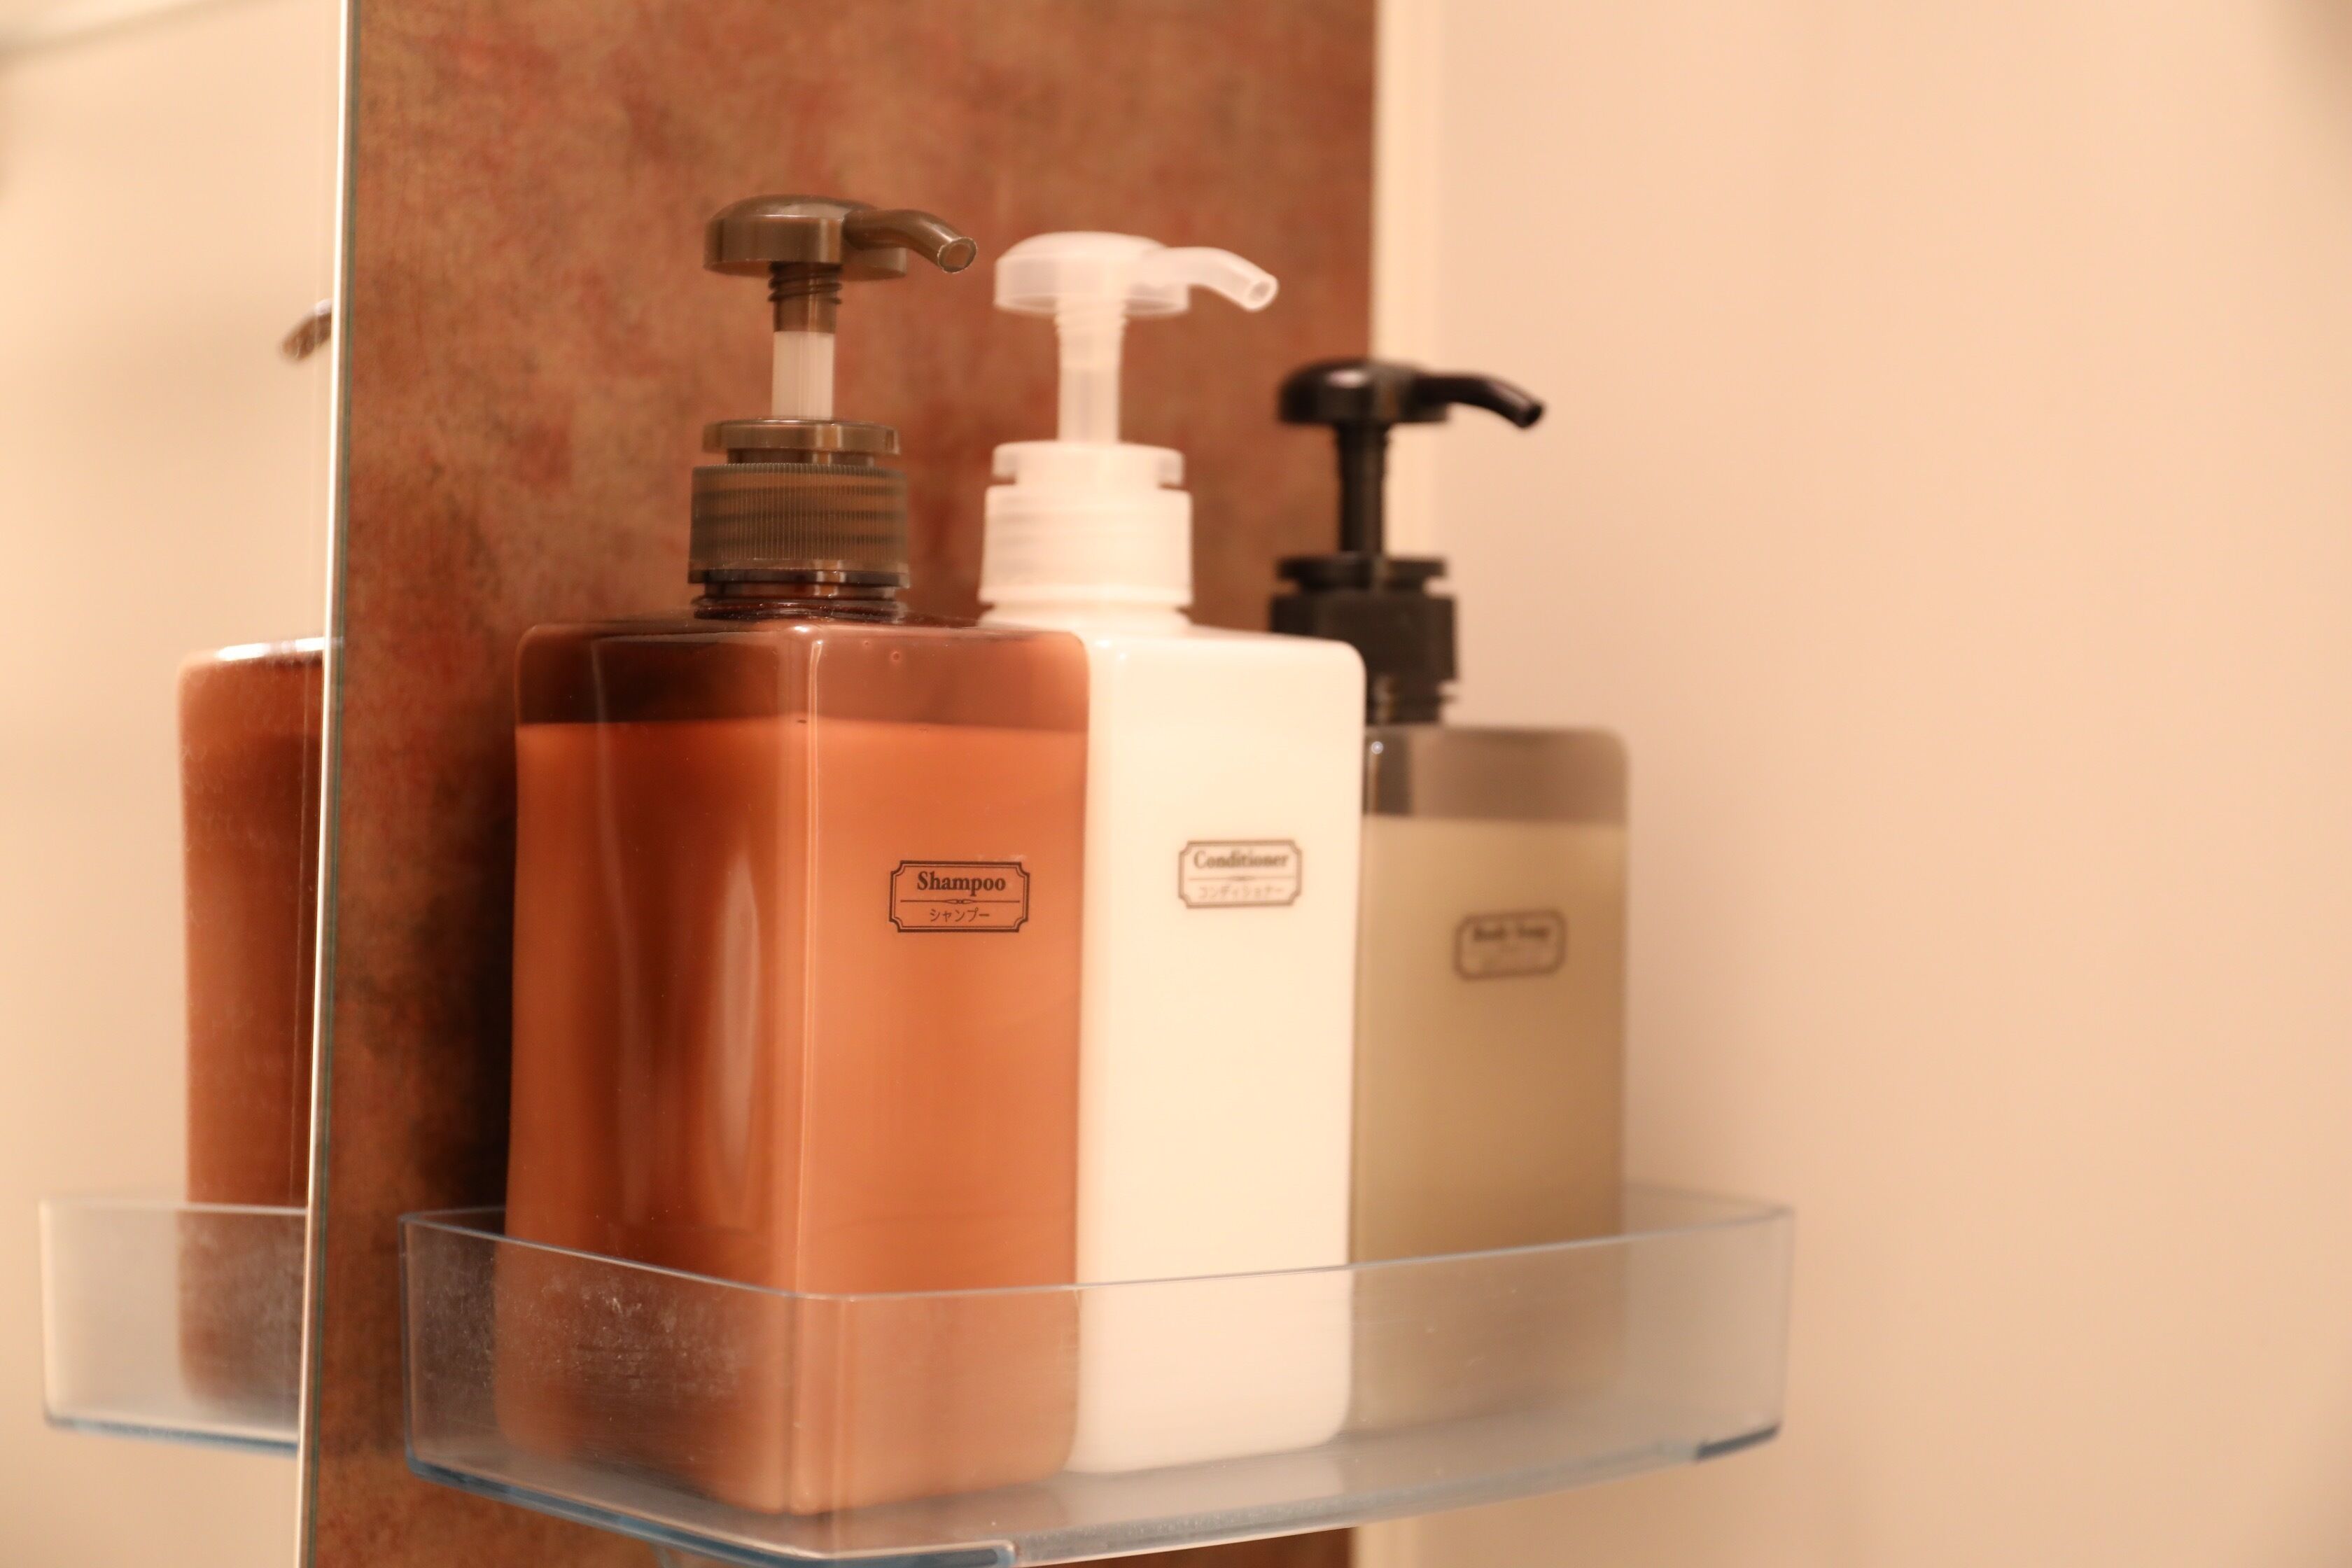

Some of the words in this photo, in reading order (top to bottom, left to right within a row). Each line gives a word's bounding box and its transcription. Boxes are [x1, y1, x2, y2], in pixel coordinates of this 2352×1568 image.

[1194, 849, 1289, 869] Conditioner
[917, 871, 1007, 897] Shampoo
[930, 907, 990, 923] シャンプー
